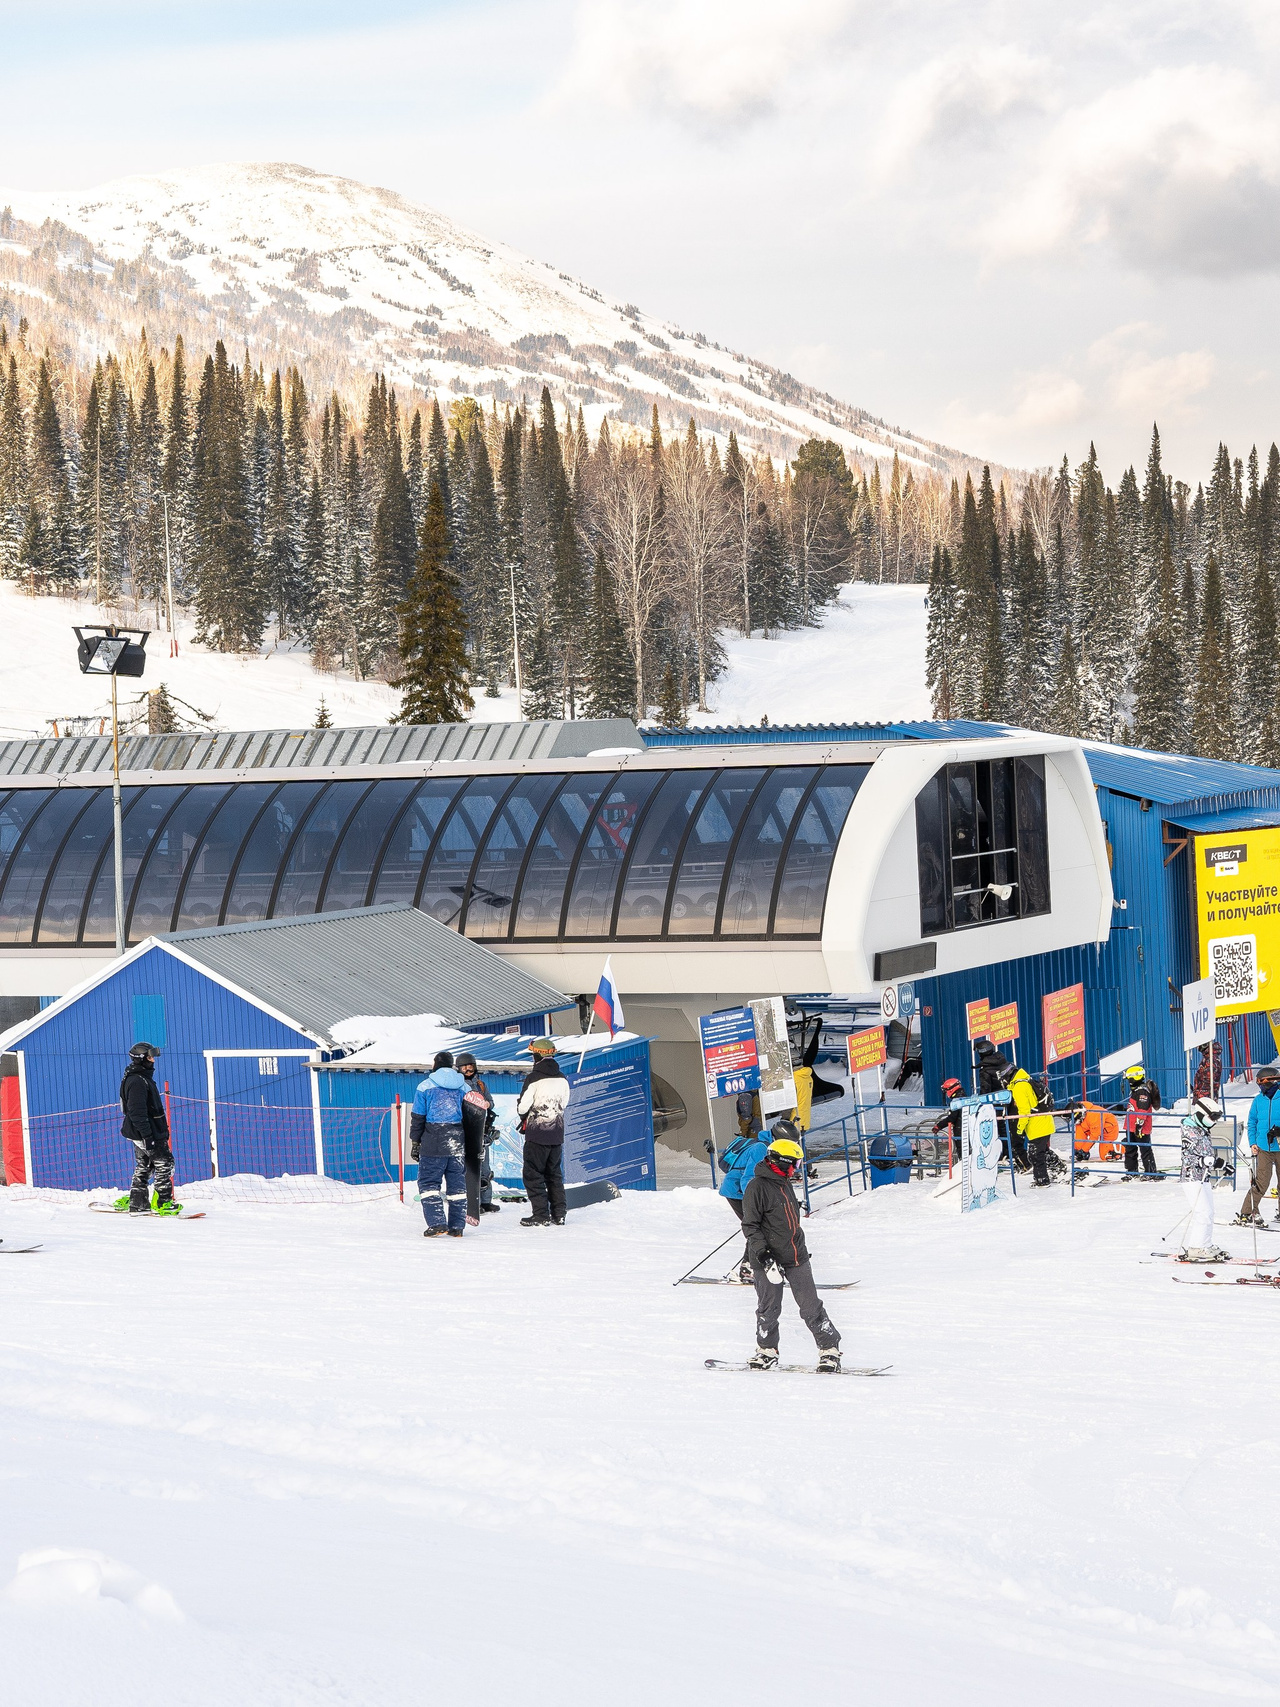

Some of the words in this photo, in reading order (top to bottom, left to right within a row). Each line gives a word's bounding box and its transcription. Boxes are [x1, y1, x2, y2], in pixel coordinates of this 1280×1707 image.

[1211, 850, 1242, 861] КВЕСТ
[1206, 885, 1278, 904] Участвуйте
[1207, 910, 1215, 922] и
[1191, 1007, 1209, 1033] VIP
[851, 1035, 870, 1047] ПЕРЕВОЗКА
[869, 1032, 878, 1041] ЛЫЖ
[994, 1026, 1015, 1041] ЗАПРЕЩЕНА
[851, 1044, 872, 1058] СНОУБОРДОВ
[874, 1040, 884, 1050] РУКАХ
[856, 1050, 881, 1068] ЗАПРЕЩЕНА
